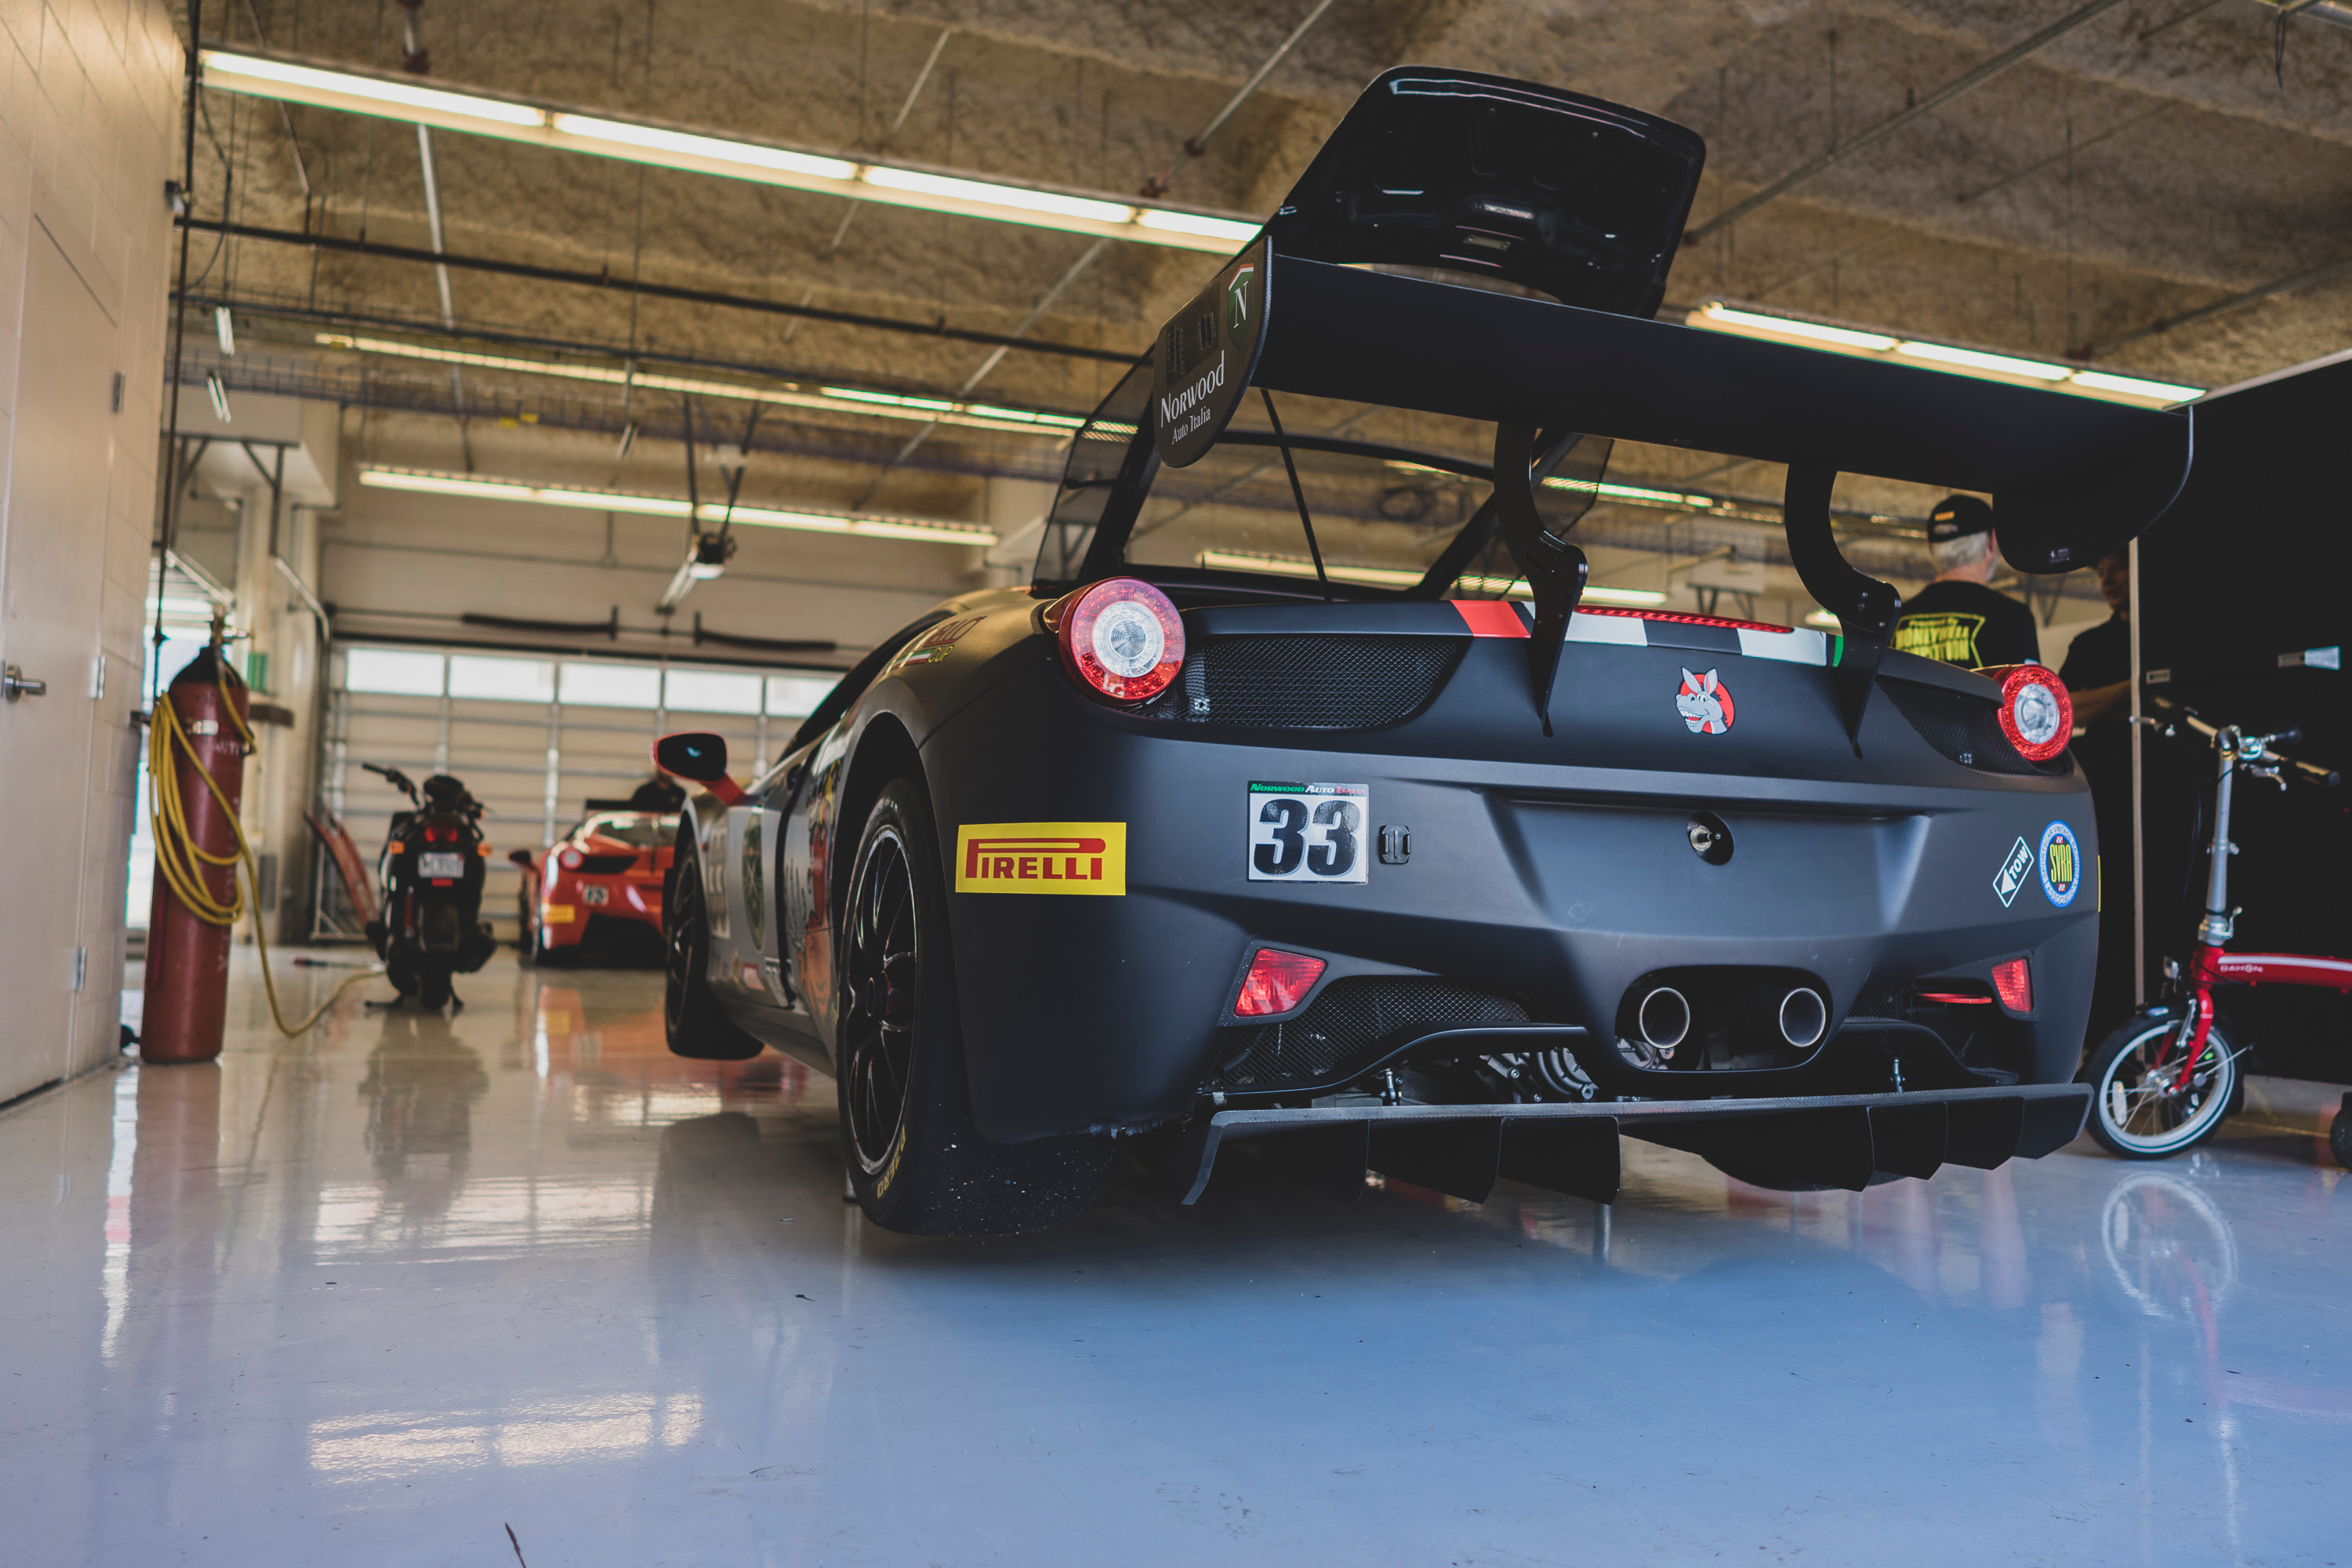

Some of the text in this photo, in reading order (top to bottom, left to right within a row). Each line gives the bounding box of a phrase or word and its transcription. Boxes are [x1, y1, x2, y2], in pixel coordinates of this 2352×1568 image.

[1171, 406, 1211, 445] Auto Italia
[928, 645, 954, 663] CUP
[1254, 798, 1361, 877] 33
[965, 837, 1106, 880] PIRELLI
[2008, 845, 2029, 880] TOW
[2049, 844, 2072, 882] SVRA
